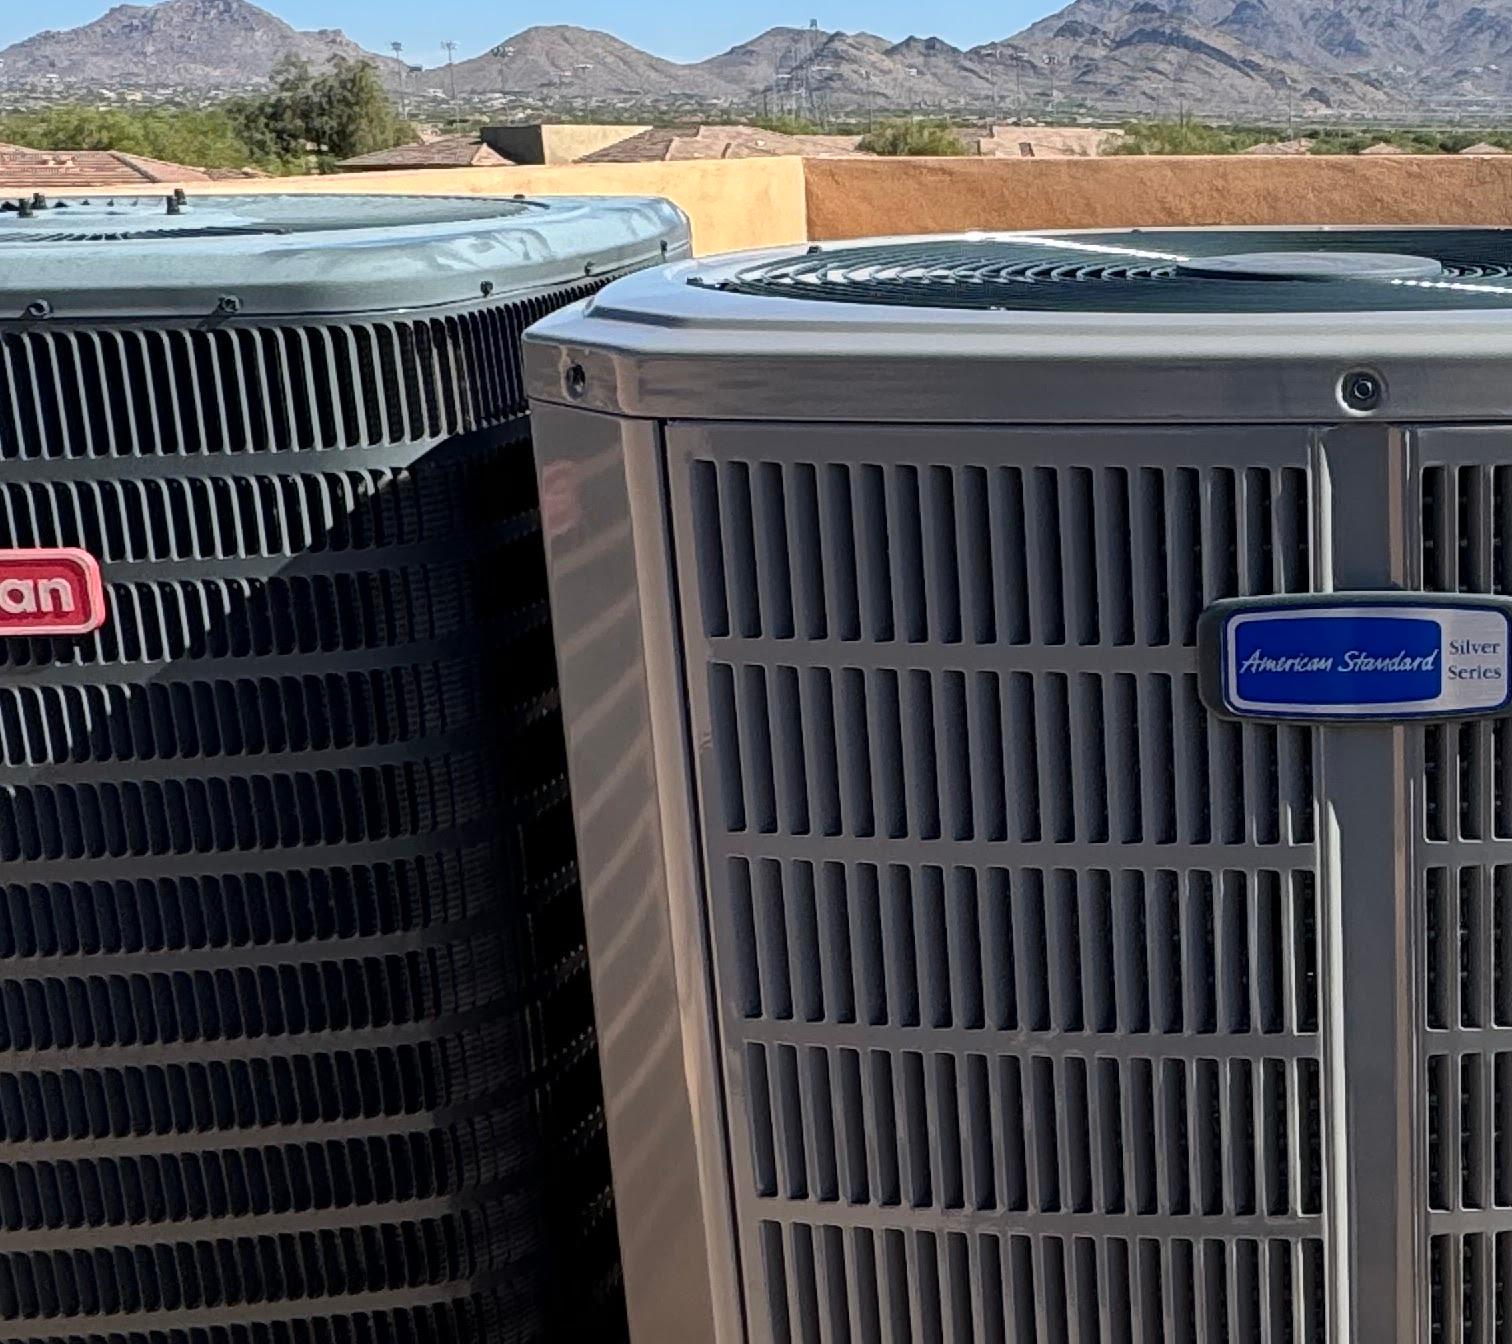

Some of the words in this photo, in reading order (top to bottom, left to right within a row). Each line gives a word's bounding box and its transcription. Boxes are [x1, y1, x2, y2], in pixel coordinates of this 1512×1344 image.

[1449, 639, 1501, 655] Silver
[1239, 648, 1333, 674] American
[1337, 648, 1440, 673] Standard
[1448, 664, 1502, 680] Series
